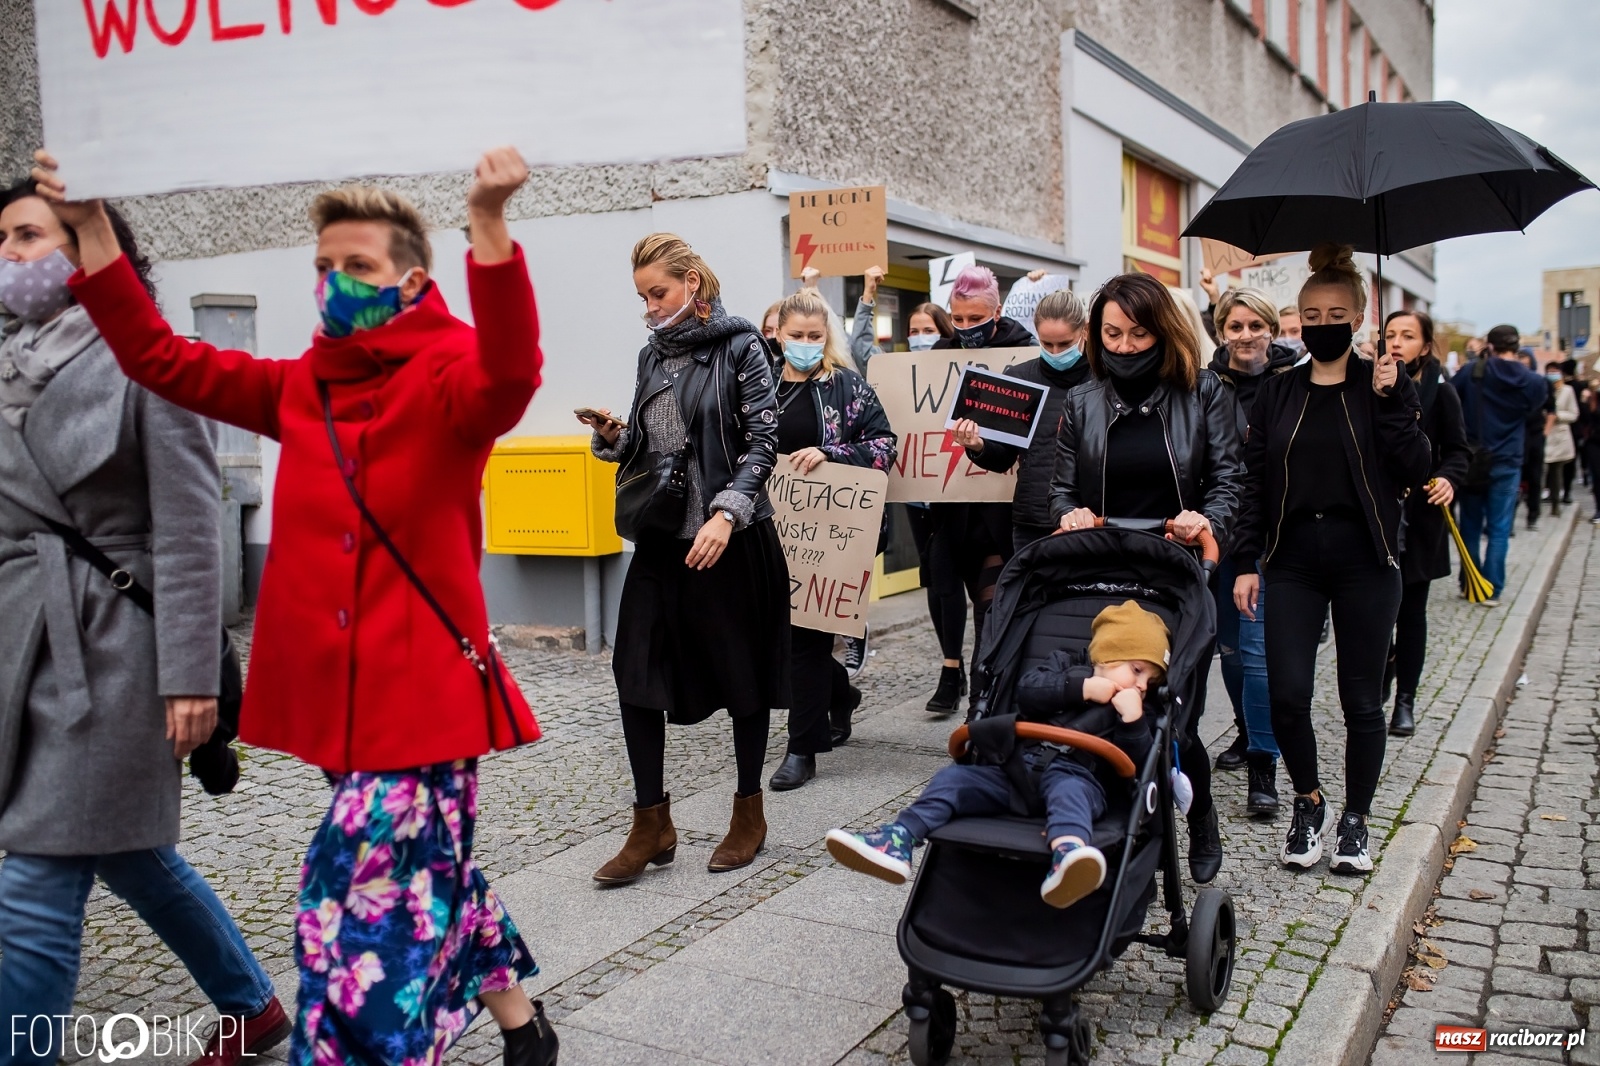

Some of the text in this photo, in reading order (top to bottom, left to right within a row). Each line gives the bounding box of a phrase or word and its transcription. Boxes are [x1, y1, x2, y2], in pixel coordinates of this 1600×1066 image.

[801, 188, 873, 208] WE WON'T
[822, 211, 848, 227] GO
[969, 379, 1032, 401] ZAPRASZAMY
[965, 398, 1031, 422] WYPIERDALAĆ
[774, 515, 818, 541] ŃSKI
[804, 570, 871, 620] NIE!
